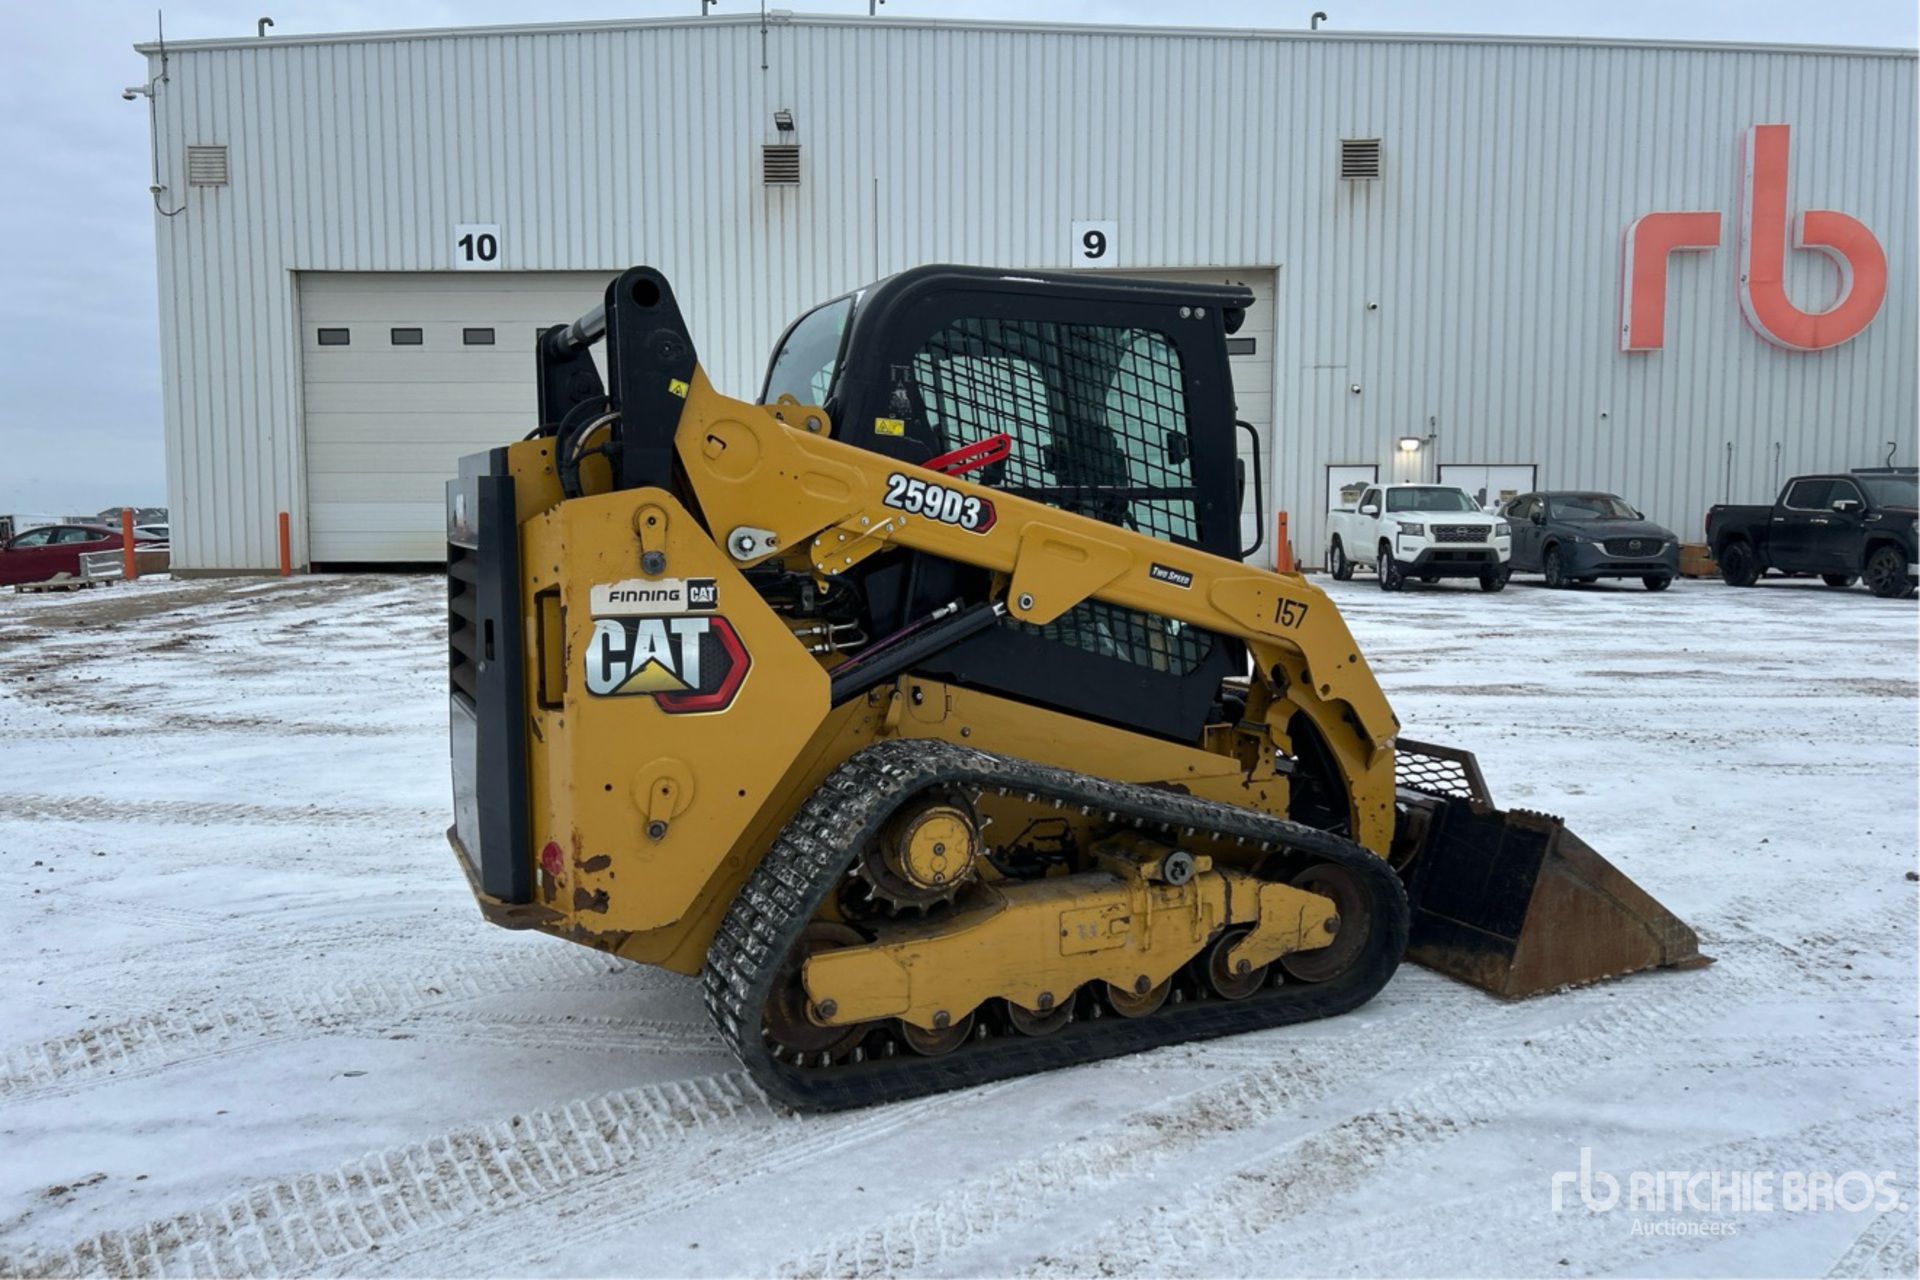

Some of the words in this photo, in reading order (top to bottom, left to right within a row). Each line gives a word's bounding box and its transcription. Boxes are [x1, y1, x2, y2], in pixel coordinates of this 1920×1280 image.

[458, 233, 498, 261] 10
[1083, 230, 1107, 259] 9
[1620, 124, 1887, 351] rb
[884, 473, 982, 529] 259D3
[609, 589, 681, 603] FINNING
[690, 586, 715, 602] CAT
[1274, 597, 1309, 630] 157
[585, 617, 710, 695] CAT
